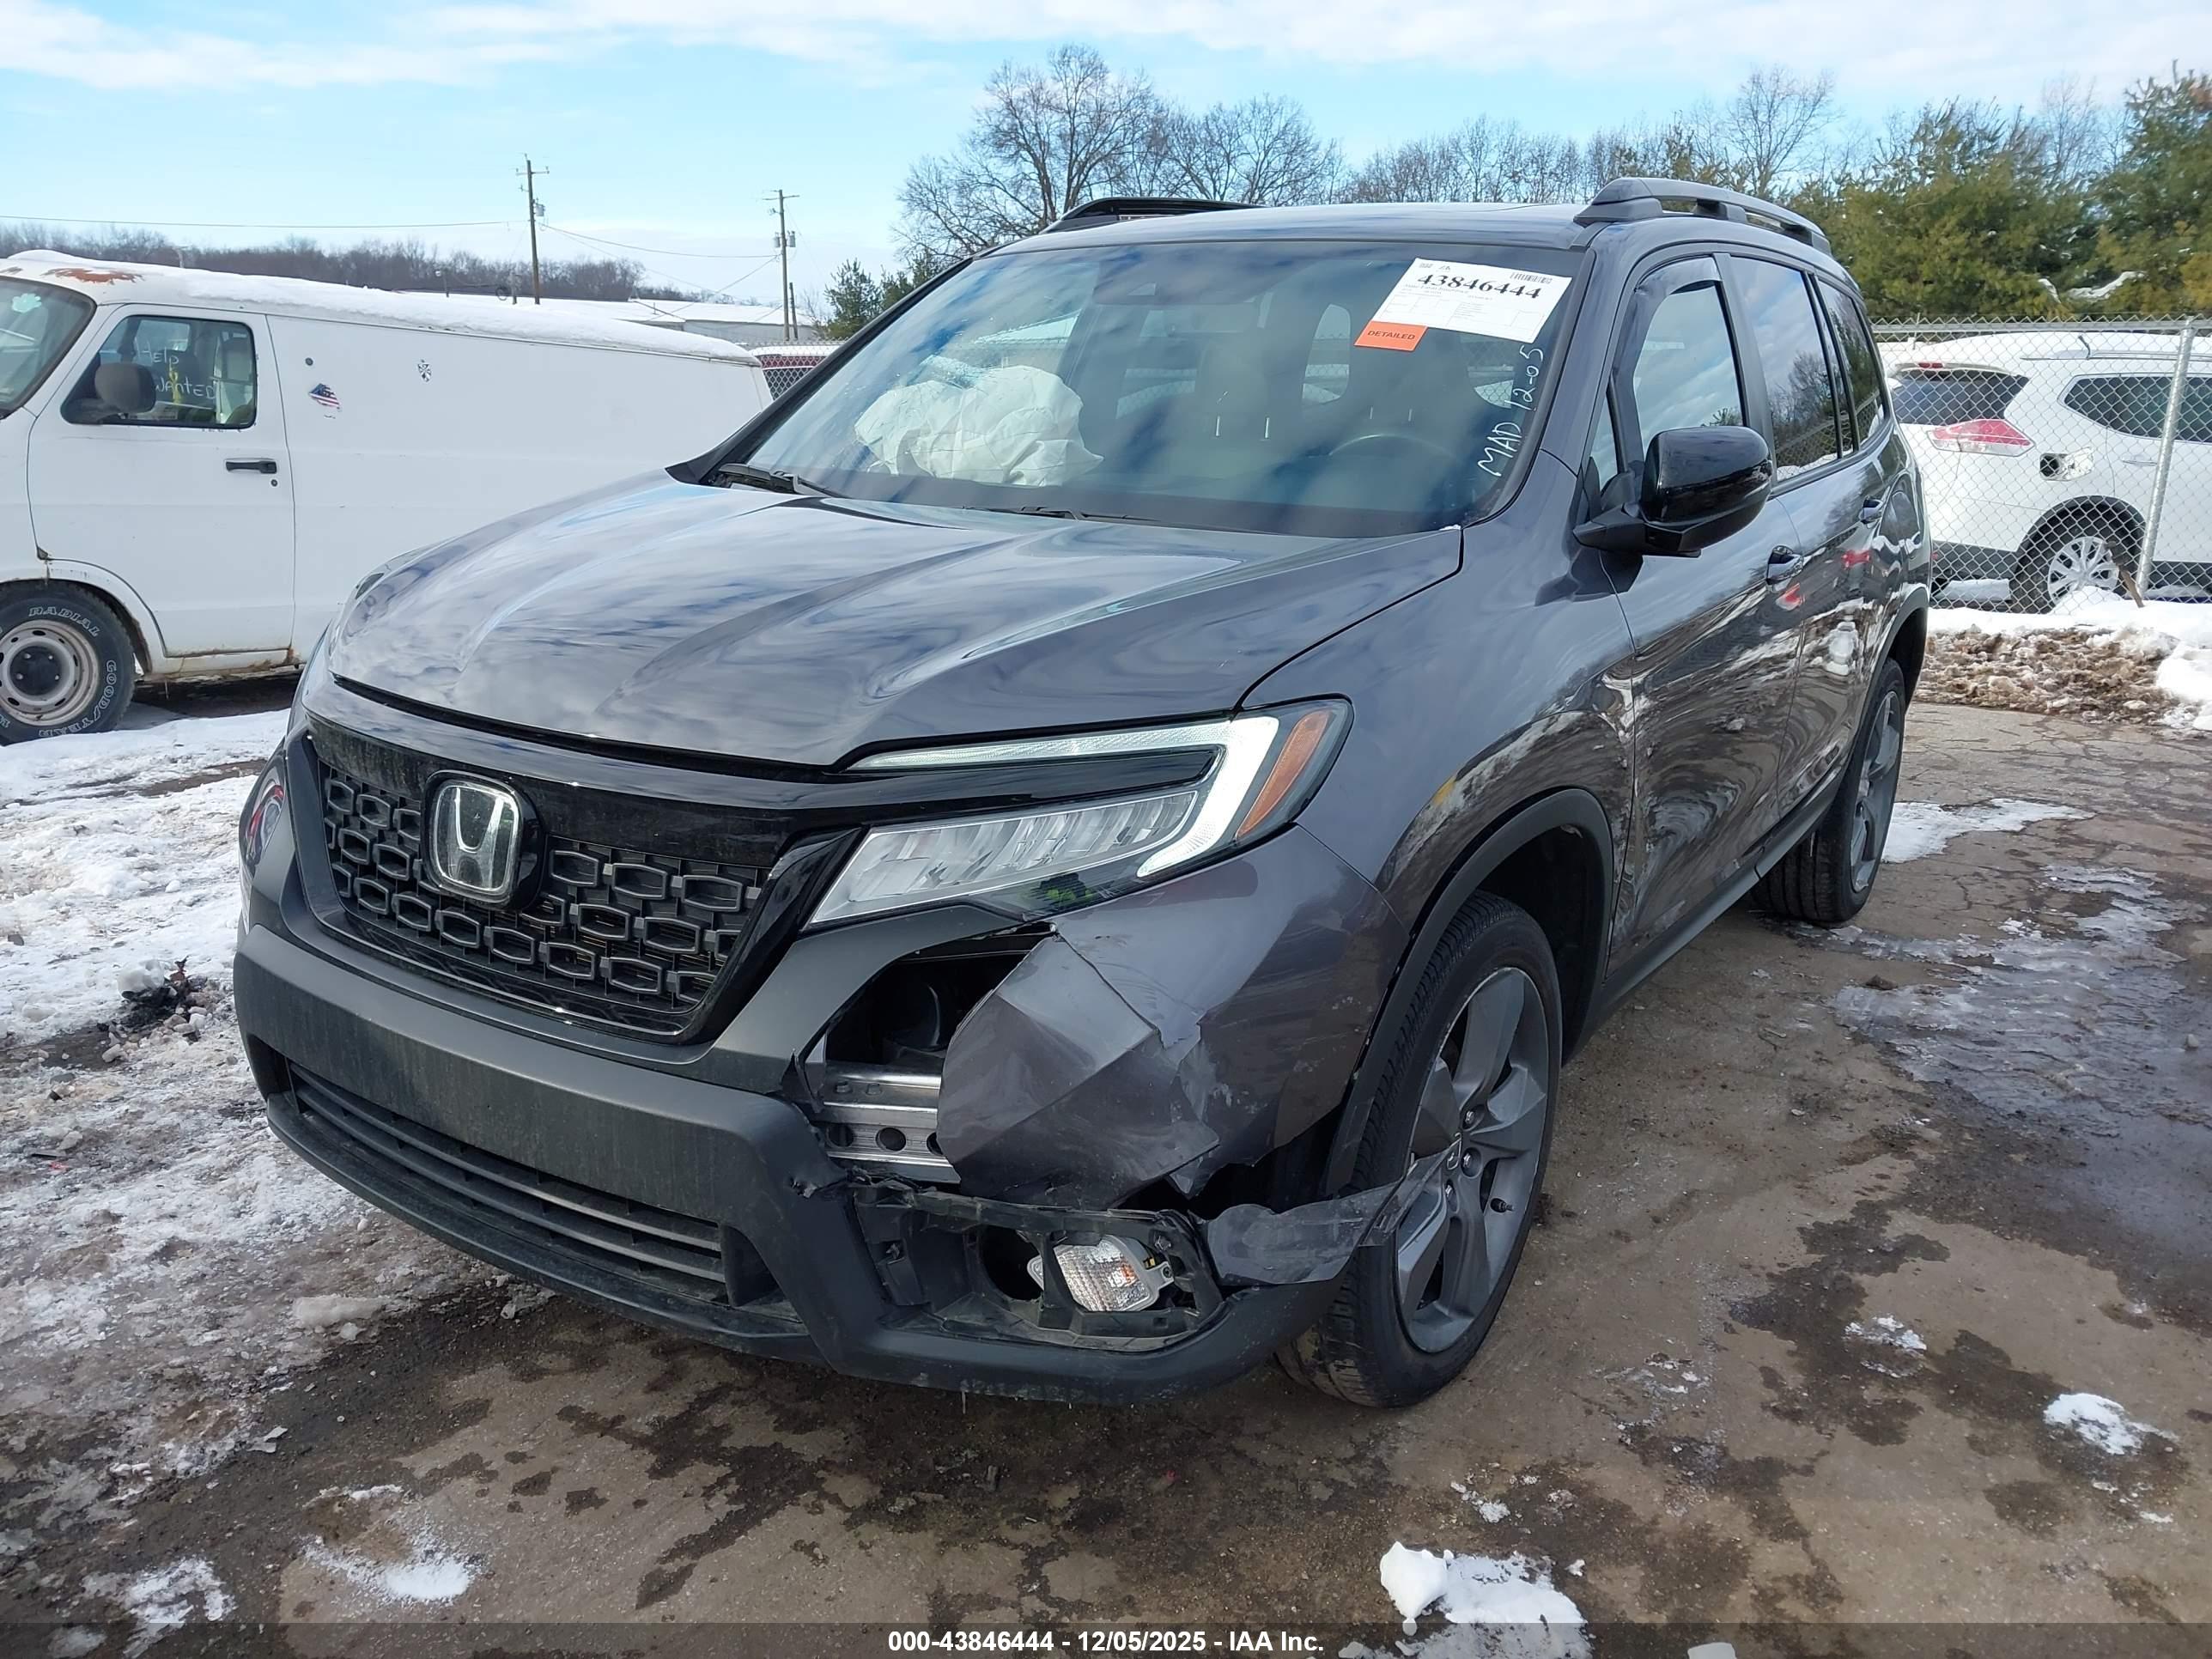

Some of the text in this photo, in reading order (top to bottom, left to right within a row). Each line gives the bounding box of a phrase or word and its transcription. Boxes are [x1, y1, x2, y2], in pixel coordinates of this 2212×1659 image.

[1417, 273, 1543, 300] 43846444
[1367, 329, 1416, 341] DETAILED
[1477, 344, 1544, 477] MAD 12-05
[28, 606, 100, 637] RADIAL
[39, 659, 117, 738] GOODYEAR
